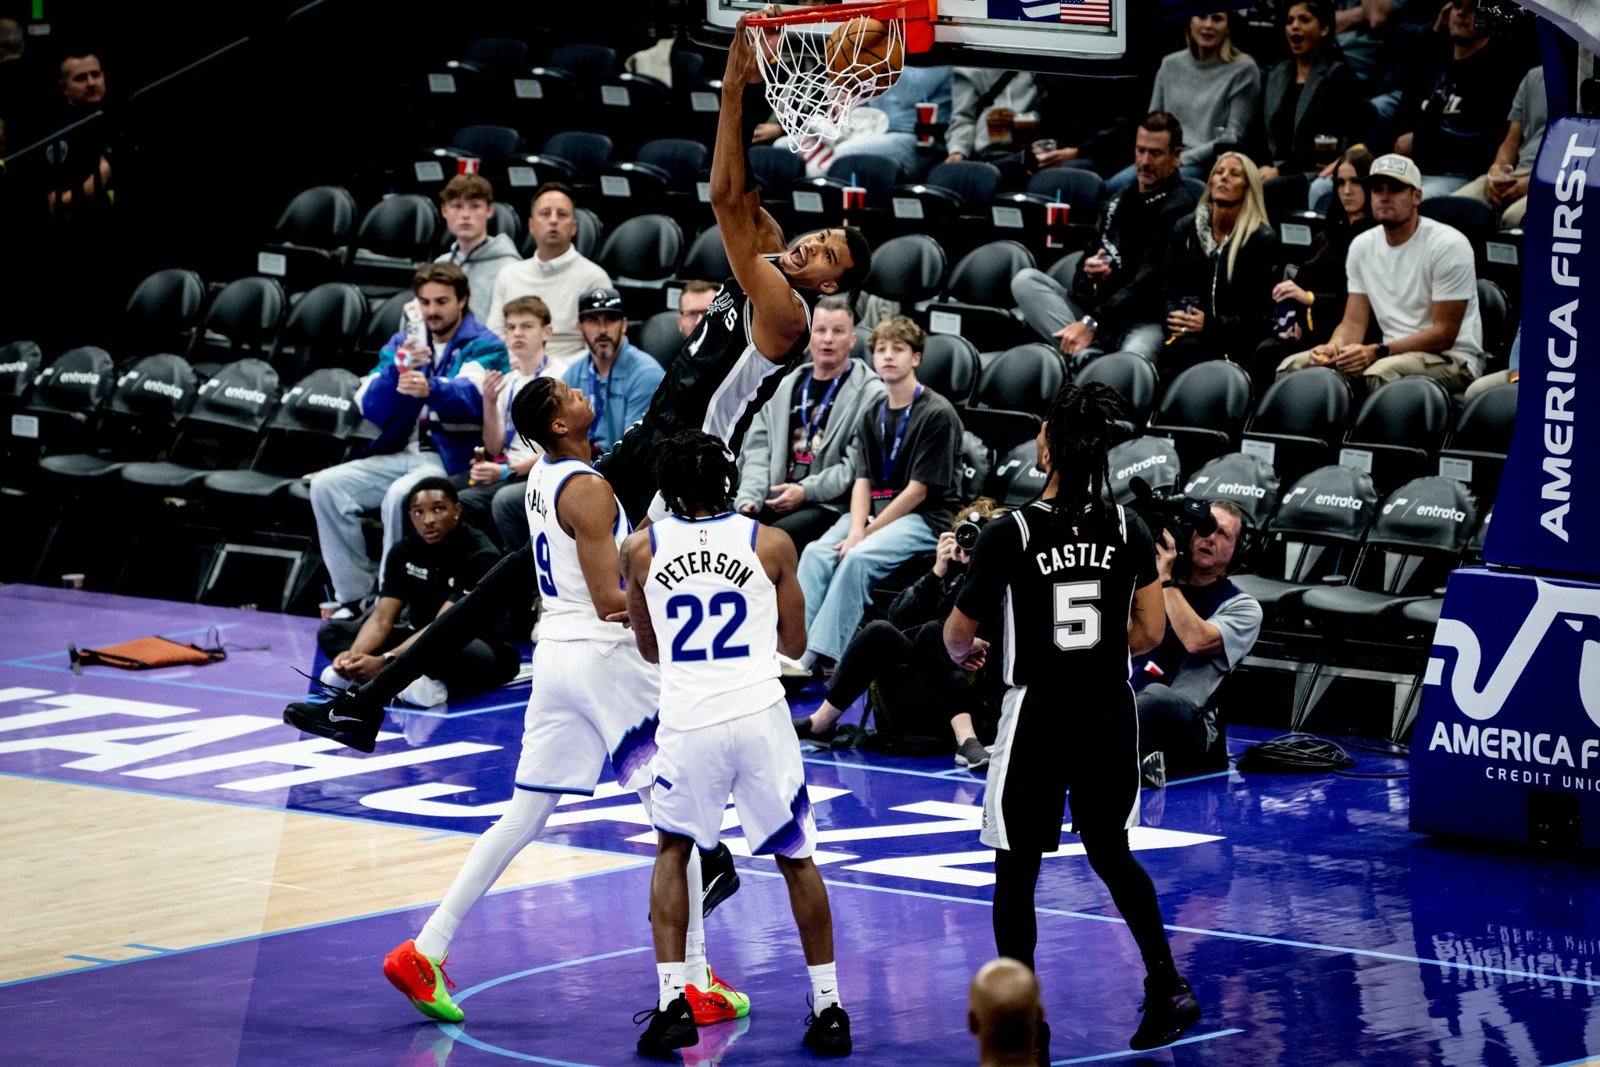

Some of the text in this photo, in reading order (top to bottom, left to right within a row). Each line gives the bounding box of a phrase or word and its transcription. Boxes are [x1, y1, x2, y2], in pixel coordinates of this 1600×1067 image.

[1540, 132, 1597, 543] AMERICA FIRST
[59, 371, 101, 386] entrata
[143, 378, 184, 401] entrata
[224, 384, 267, 405] entrata
[307, 392, 352, 412] entrata
[1117, 453, 1167, 480] entrata
[1217, 482, 1267, 500] entrata
[1314, 491, 1363, 511] entrata
[1416, 502, 1467, 524] entrata
[531, 530, 559, 598] 9
[654, 550, 755, 591] PETERSON
[1036, 543, 1116, 576] CASTLE
[665, 590, 751, 662] 22
[1053, 579, 1102, 652] 5
[0, 686, 503, 794] TAH
[1428, 720, 1575, 768] AMERICA
[1486, 766, 1551, 786] CREDIT
